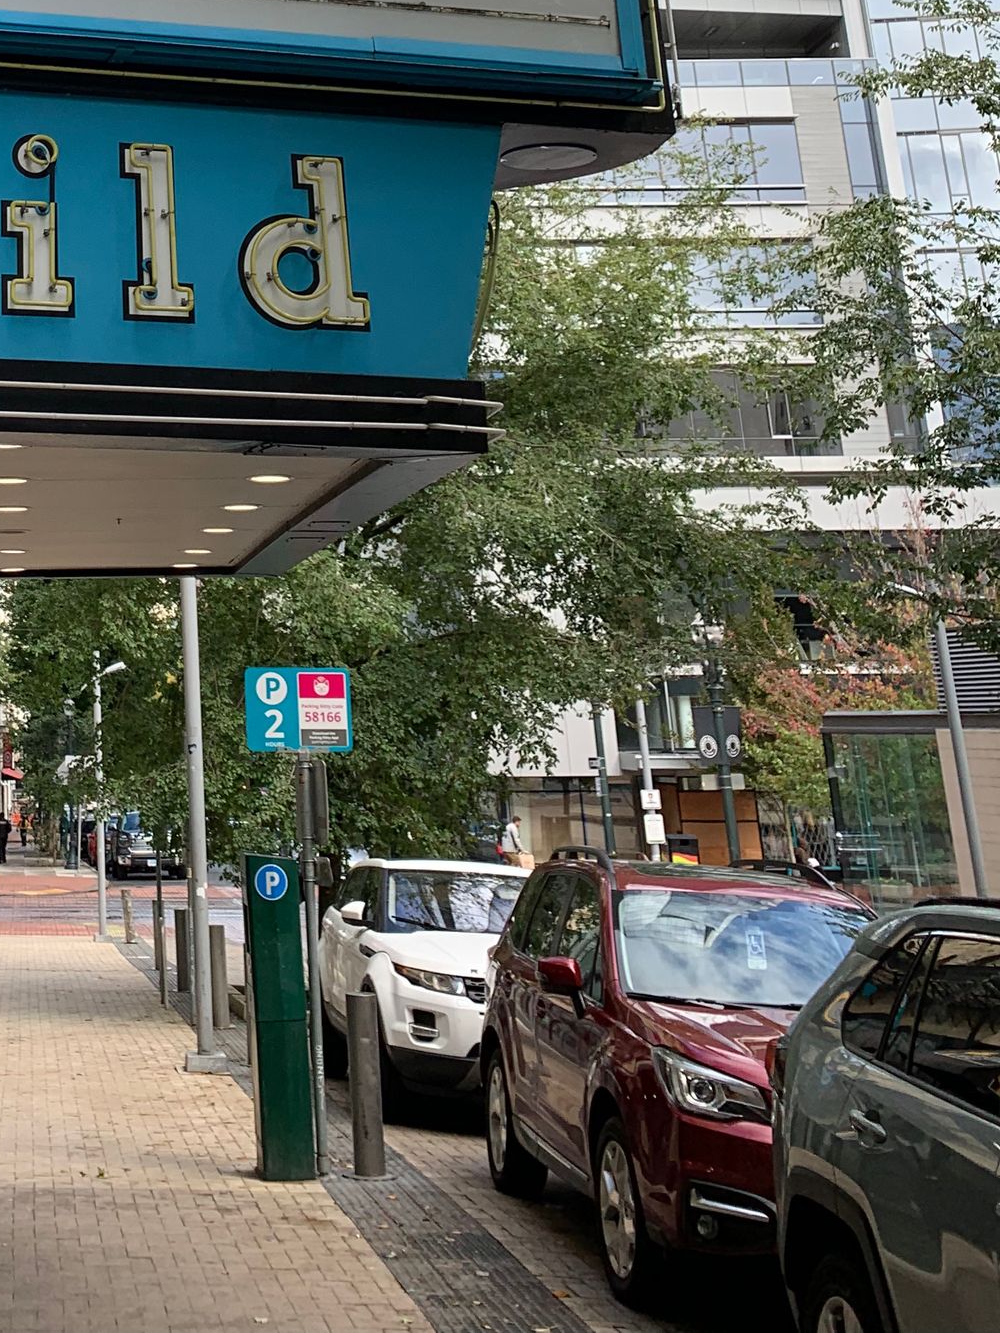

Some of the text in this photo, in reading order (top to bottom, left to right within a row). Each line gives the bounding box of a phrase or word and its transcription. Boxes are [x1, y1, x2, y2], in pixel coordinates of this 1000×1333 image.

[265, 677, 281, 700] P
[264, 709, 285, 739] 2
[304, 711, 341, 723] 58166
[265, 872, 280, 895] P
